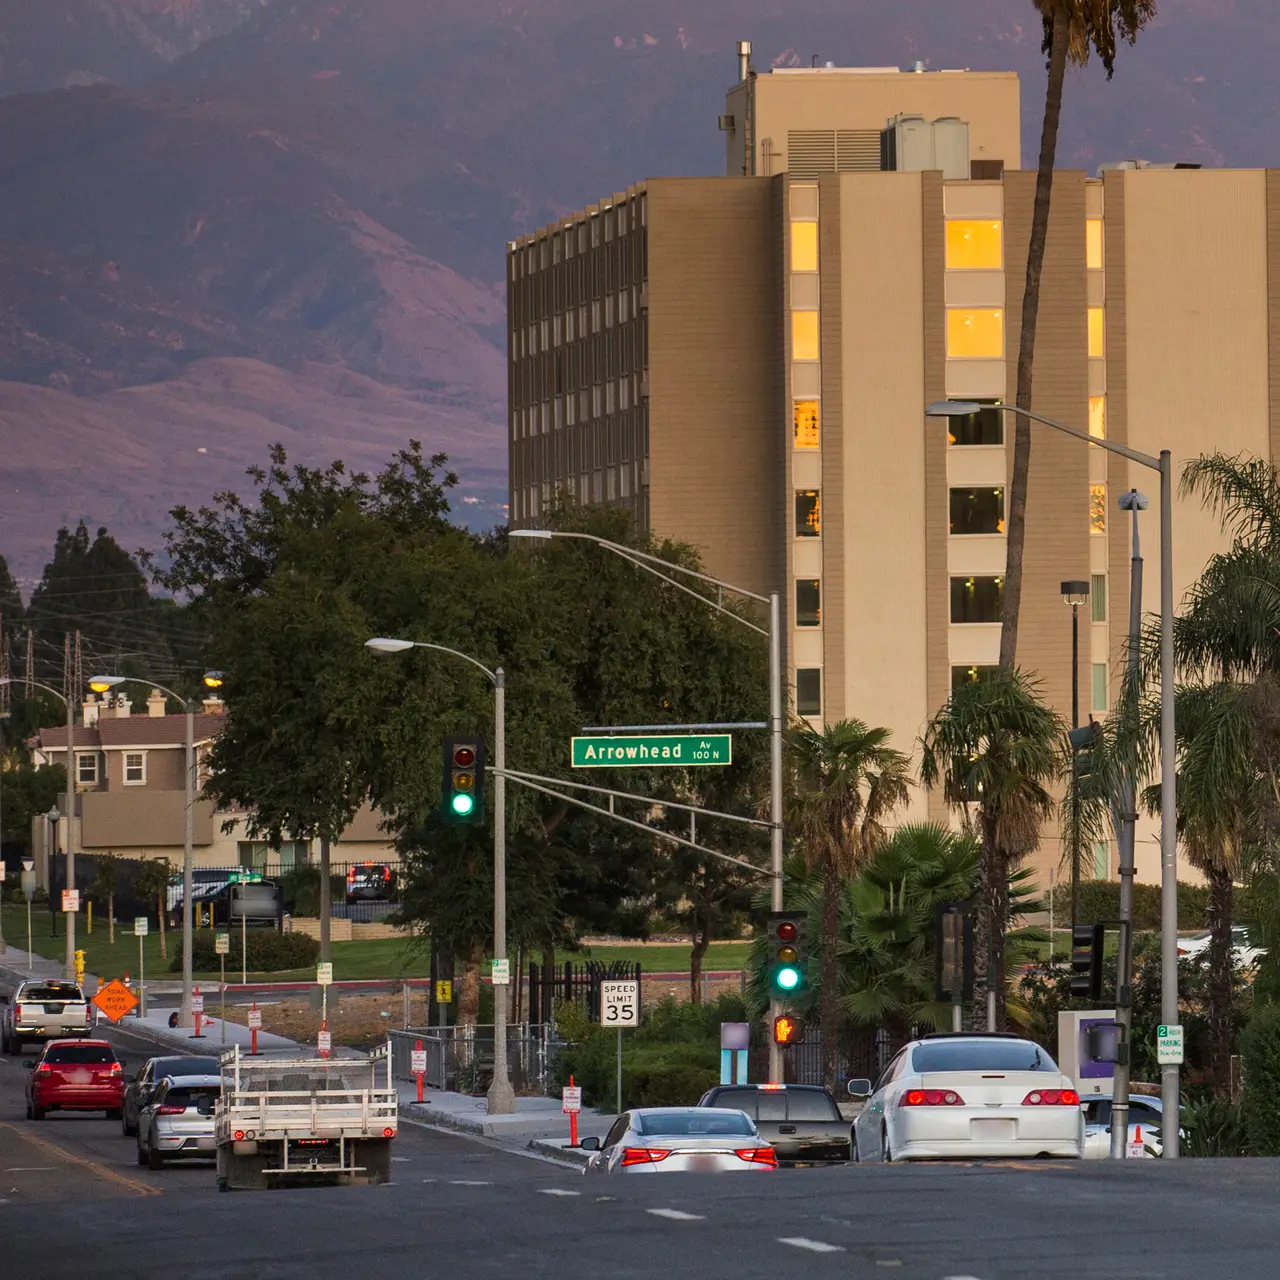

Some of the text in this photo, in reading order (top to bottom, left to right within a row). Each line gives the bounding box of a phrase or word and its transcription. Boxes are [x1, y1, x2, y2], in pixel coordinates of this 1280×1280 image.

[700, 741, 711, 749] Av
[584, 744, 682, 759] Arrowhead
[692, 751, 719, 760] 100 N
[604, 985, 636, 993] SPEED
[606, 995, 632, 1003] LIMIT
[606, 1005, 634, 1021] 35
[1159, 1027, 1167, 1036] 2
